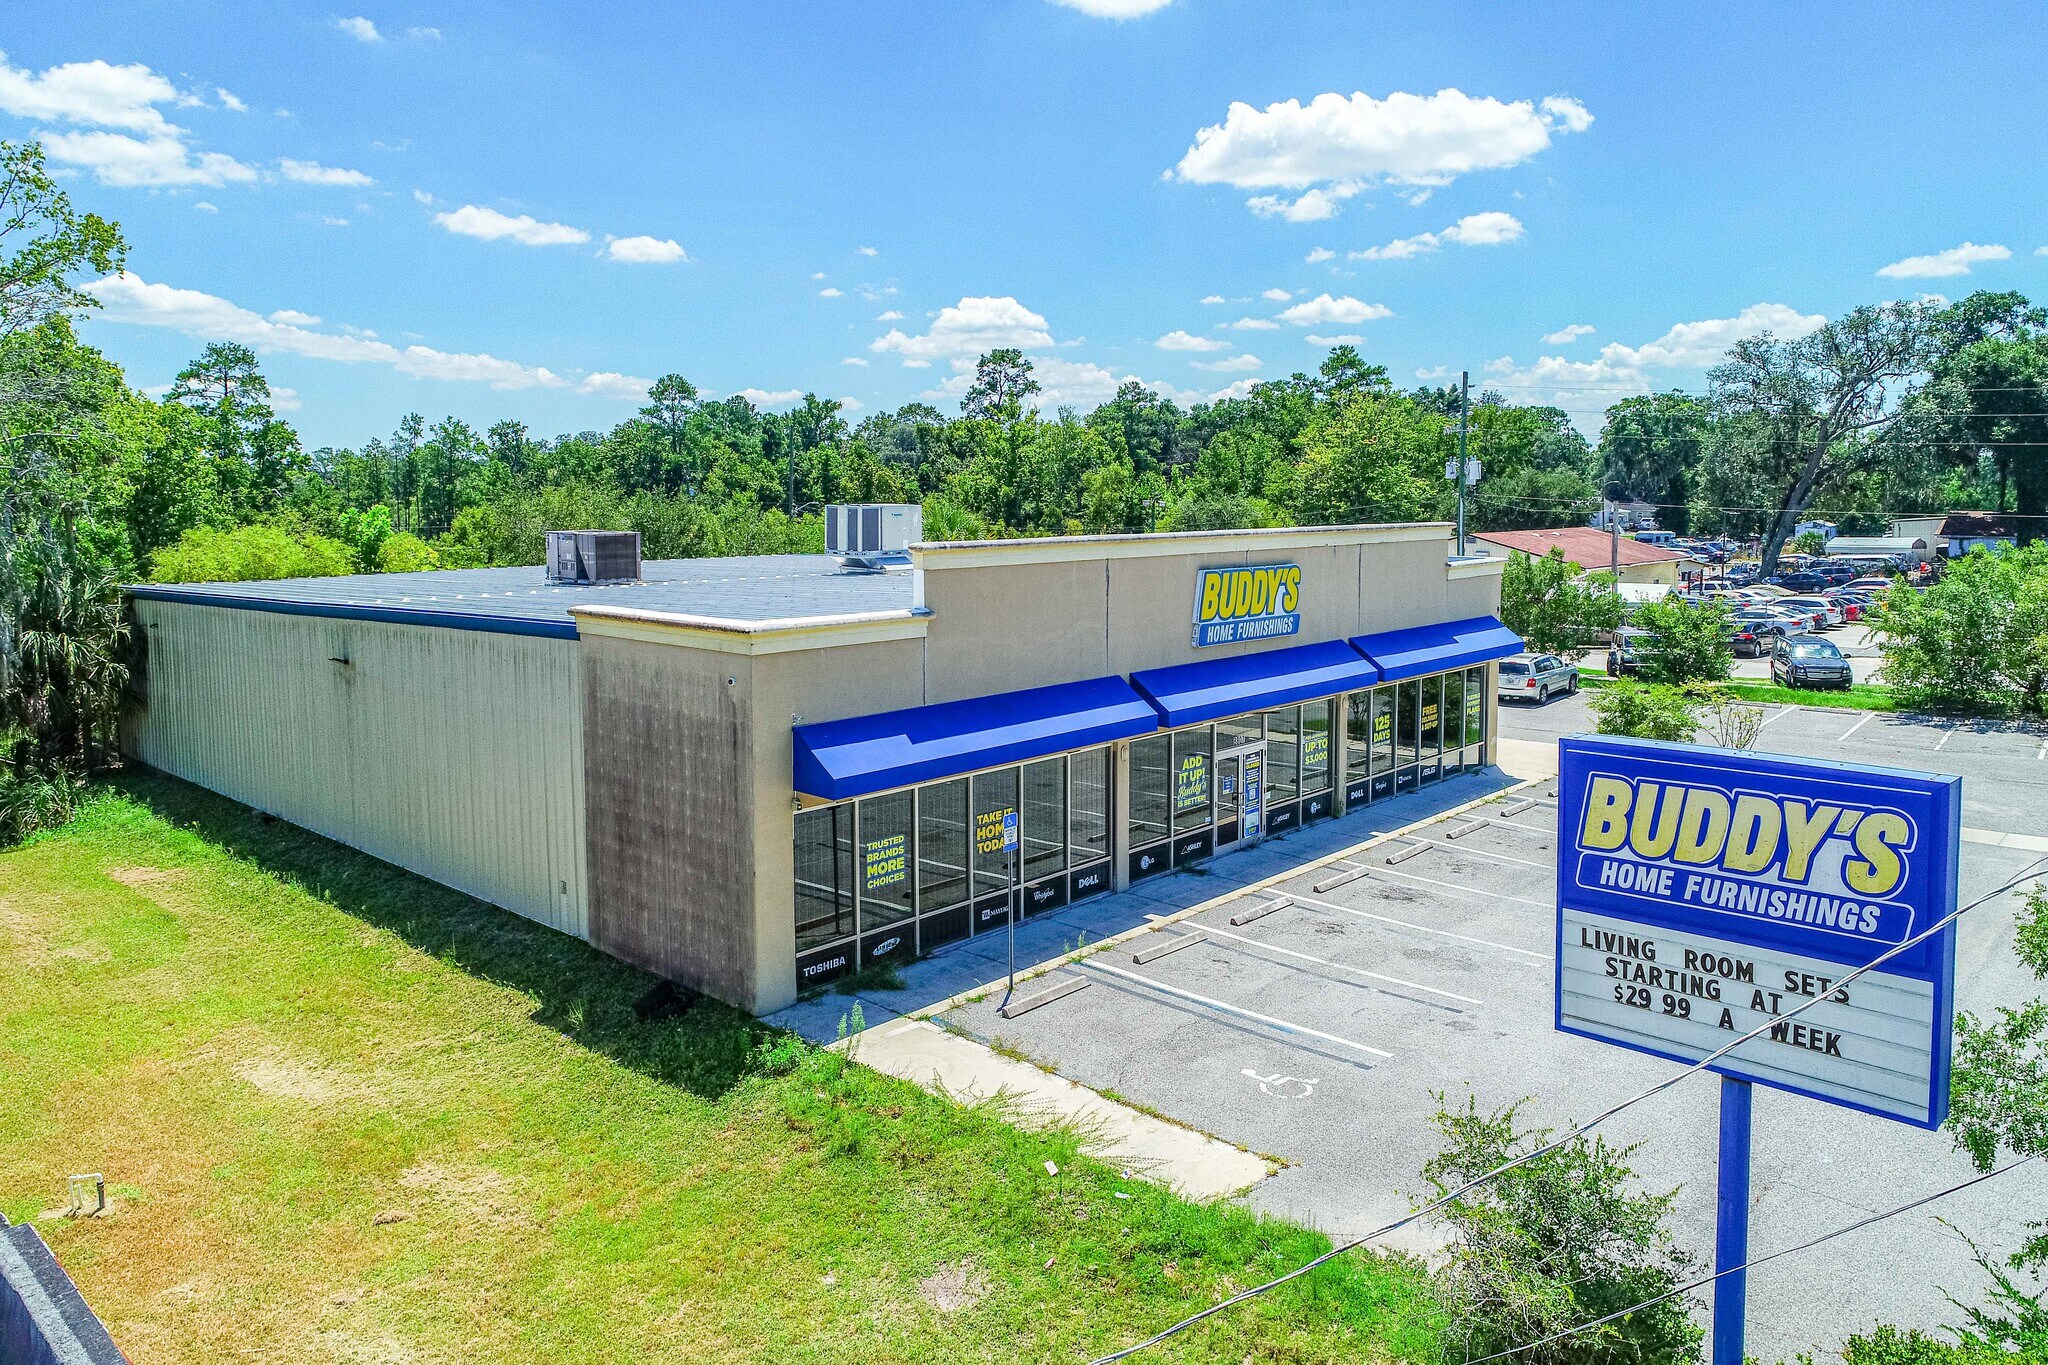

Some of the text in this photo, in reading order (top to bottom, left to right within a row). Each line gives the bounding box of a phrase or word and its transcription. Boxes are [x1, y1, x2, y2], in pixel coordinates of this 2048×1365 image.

[1201, 568, 1300, 620] BUDDY'S
[1207, 617, 1294, 643] HOME FURNISHINGS
[1422, 704, 1437, 716] FREE
[1374, 714, 1390, 731] 125
[1374, 730, 1390, 742] DAYS
[1305, 738, 1329, 753] UP TO
[1182, 755, 1203, 770] ADD
[1304, 751, 1328, 765] $3,000
[1178, 768, 1205, 785] IT UP!
[1177, 780, 1207, 800] Buddy's
[1350, 789, 1364, 800] DELL
[976, 810, 1002, 825] TAKE
[976, 822, 1004, 841] HOM
[1582, 777, 1908, 893] BUDDY'S
[866, 835, 905, 851] TRUSTED
[976, 837, 1004, 854] TODA
[866, 846, 905, 863] BRANDS
[867, 857, 905, 878] MORE
[867, 872, 905, 889] CHOICES
[1078, 874, 1099, 889] DELL
[1600, 860, 1880, 934] HOME FURNISHINGS
[803, 956, 846, 977] TOSHIBA
[1581, 928, 1850, 1004] LIVING ROOM SETS
[1605, 957, 1783, 1015] STARTING AT
[1614, 982, 1842, 1058] $29 99 A WEEK
